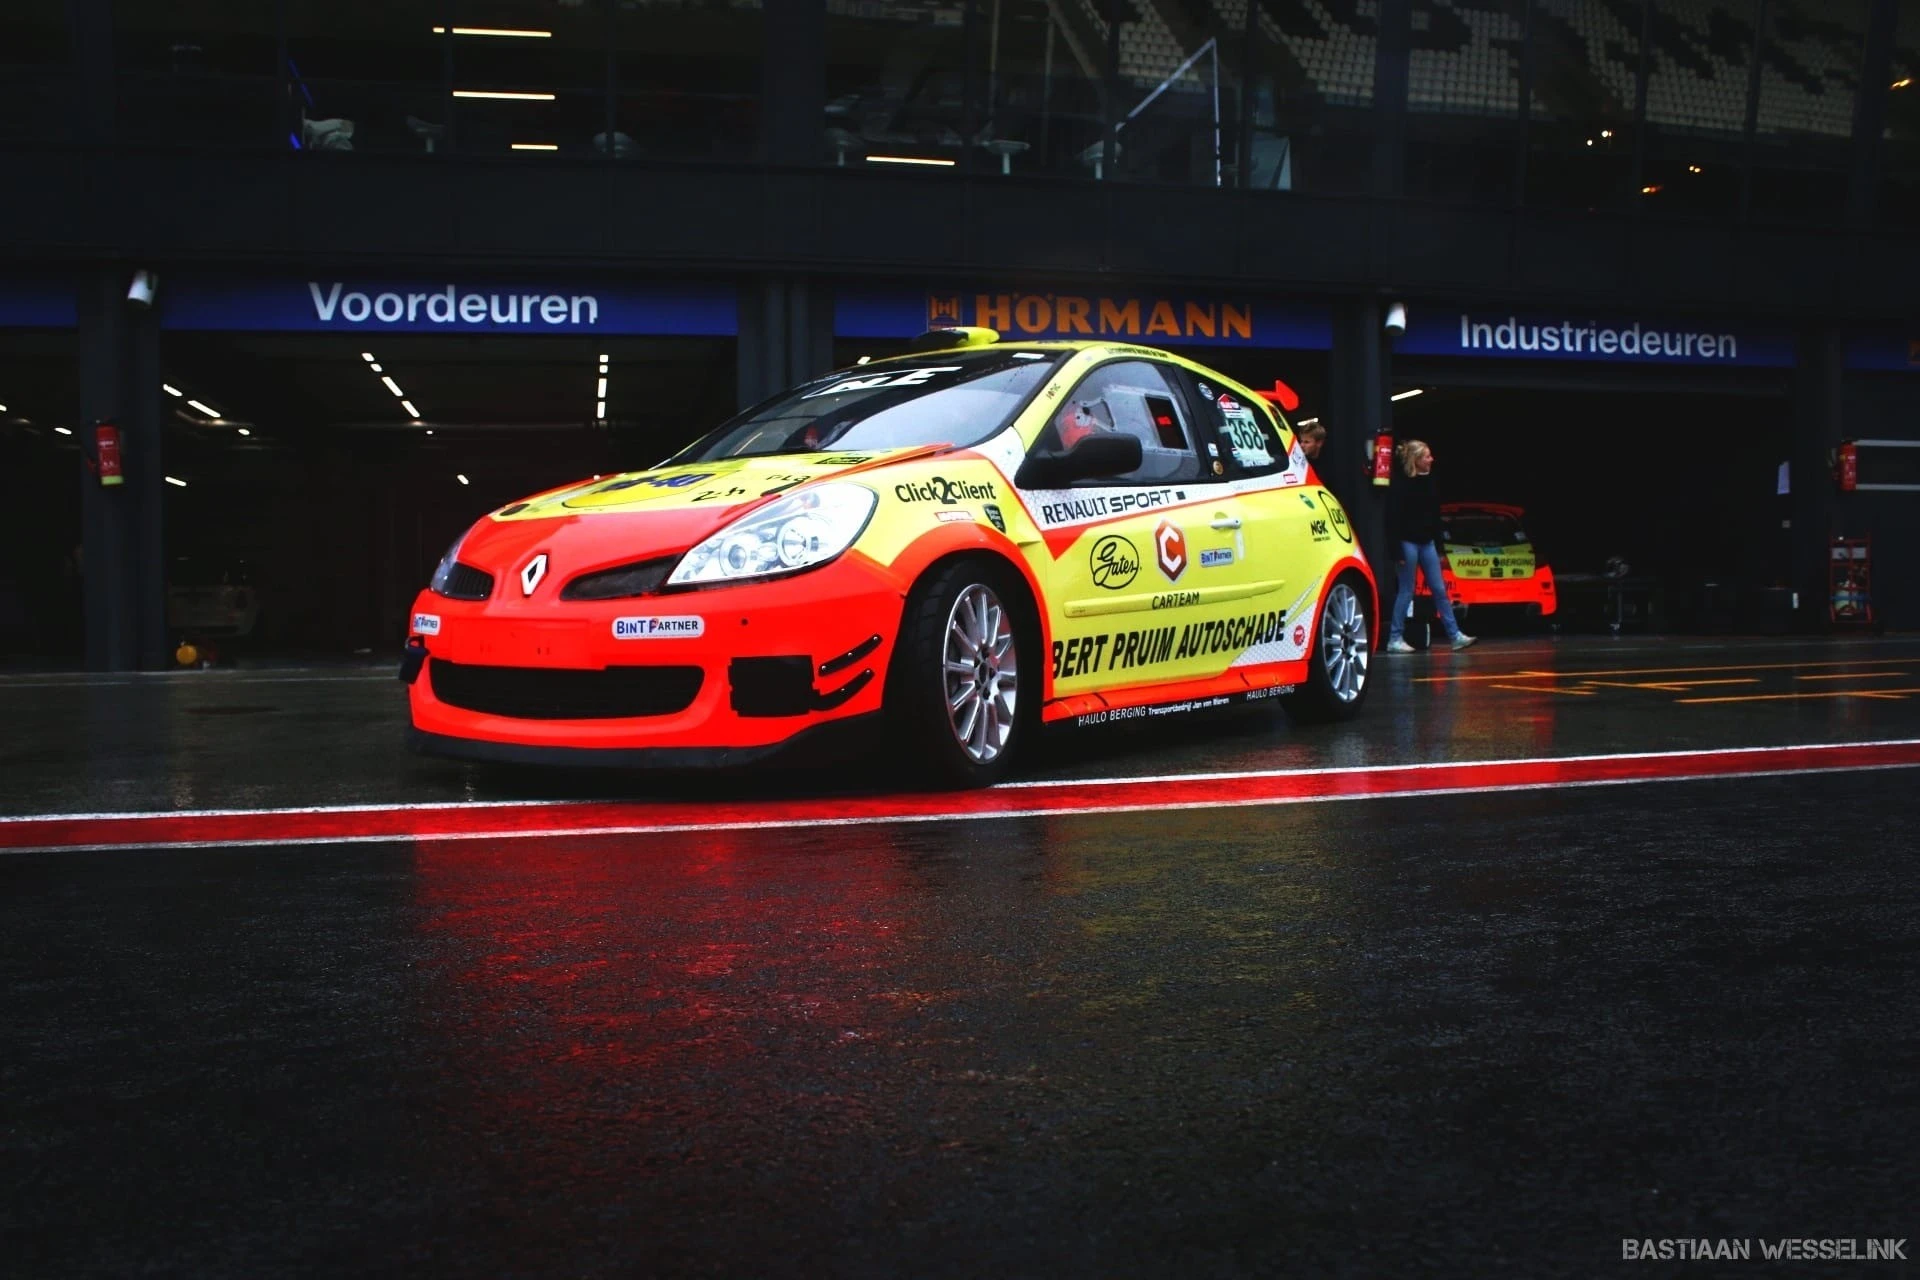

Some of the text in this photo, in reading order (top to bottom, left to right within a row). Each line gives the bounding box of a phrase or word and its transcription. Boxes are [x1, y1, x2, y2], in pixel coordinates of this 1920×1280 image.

[309, 282, 598, 324] Voordeuren
[975, 292, 1252, 338] HÖRMANN
[1460, 315, 1737, 358] Industriedeuren
[1227, 420, 1265, 451] 368
[894, 476, 997, 505] Click2Client
[1042, 489, 1171, 525] RENAULT SPORT
[1310, 520, 1328, 536] NGK
[1093, 541, 1138, 587] Gates
[1152, 591, 1200, 610] CARTEAM
[1109, 625, 1176, 671] PRUIM
[1175, 609, 1287, 660] AUTOSCHADE
[1246, 688, 1267, 701] HAULO
[1078, 711, 1107, 727] HAULO
[1109, 705, 1146, 721] BERGING
